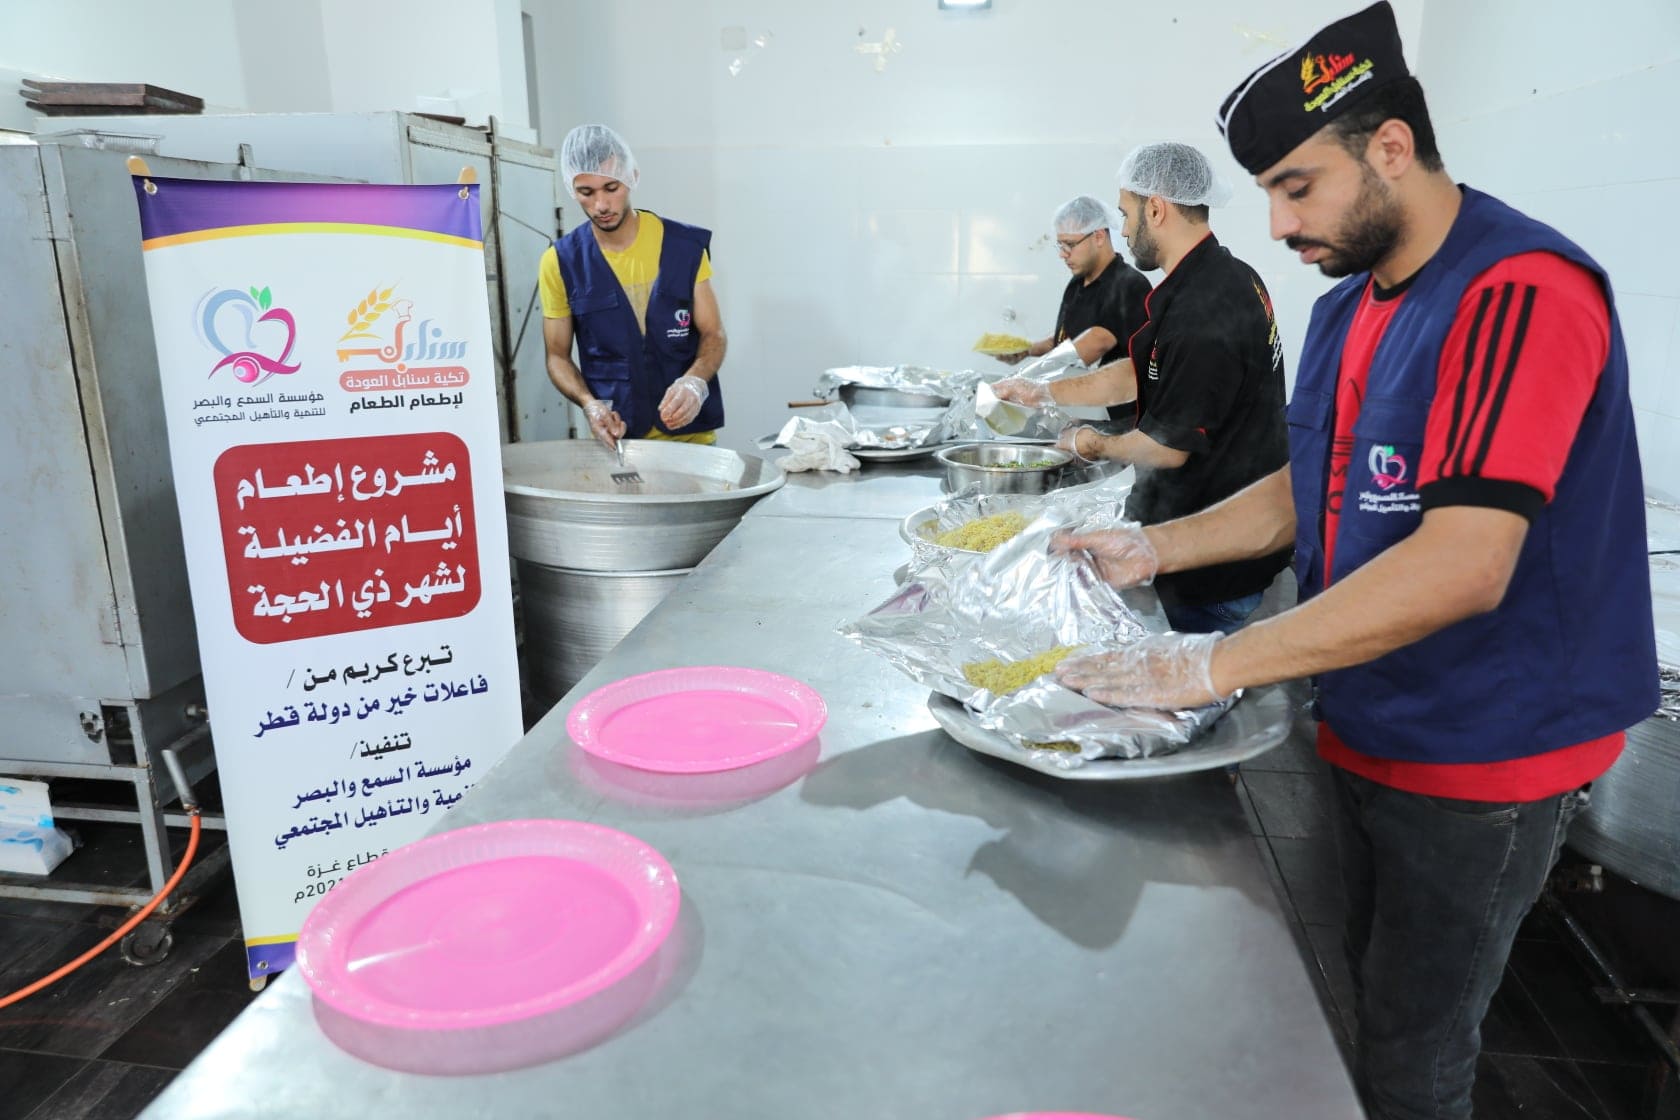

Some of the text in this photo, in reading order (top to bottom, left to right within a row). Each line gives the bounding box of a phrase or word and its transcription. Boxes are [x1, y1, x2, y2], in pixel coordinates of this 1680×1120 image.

[345, 371, 464, 390] تكية سنابل العودة
[192, 390, 325, 410] مؤسسة السمع والبصر
[349, 392, 463, 414] لإطعام الطعام
[193, 407, 326, 427] للتنمية والتأهيل المجتمعي
[236, 450, 456, 511] مشروع إطعام
[237, 504, 463, 565] أيام الفضيلة
[247, 561, 466, 624] لشهر ذي الحجة
[343, 652, 398, 685] كريم
[402, 644, 453, 676] تبرع
[303, 667, 337, 691] من
[252, 673, 489, 737] فاعلات خير من دولة قطر
[361, 766, 411, 797] السمع
[416, 755, 472, 778] مؤسسة
[291, 779, 357, 809] والبصر
[354, 796, 430, 829] والتأهيل
[274, 811, 349, 850] المجتمعي
[306, 859, 342, 879] غزة
